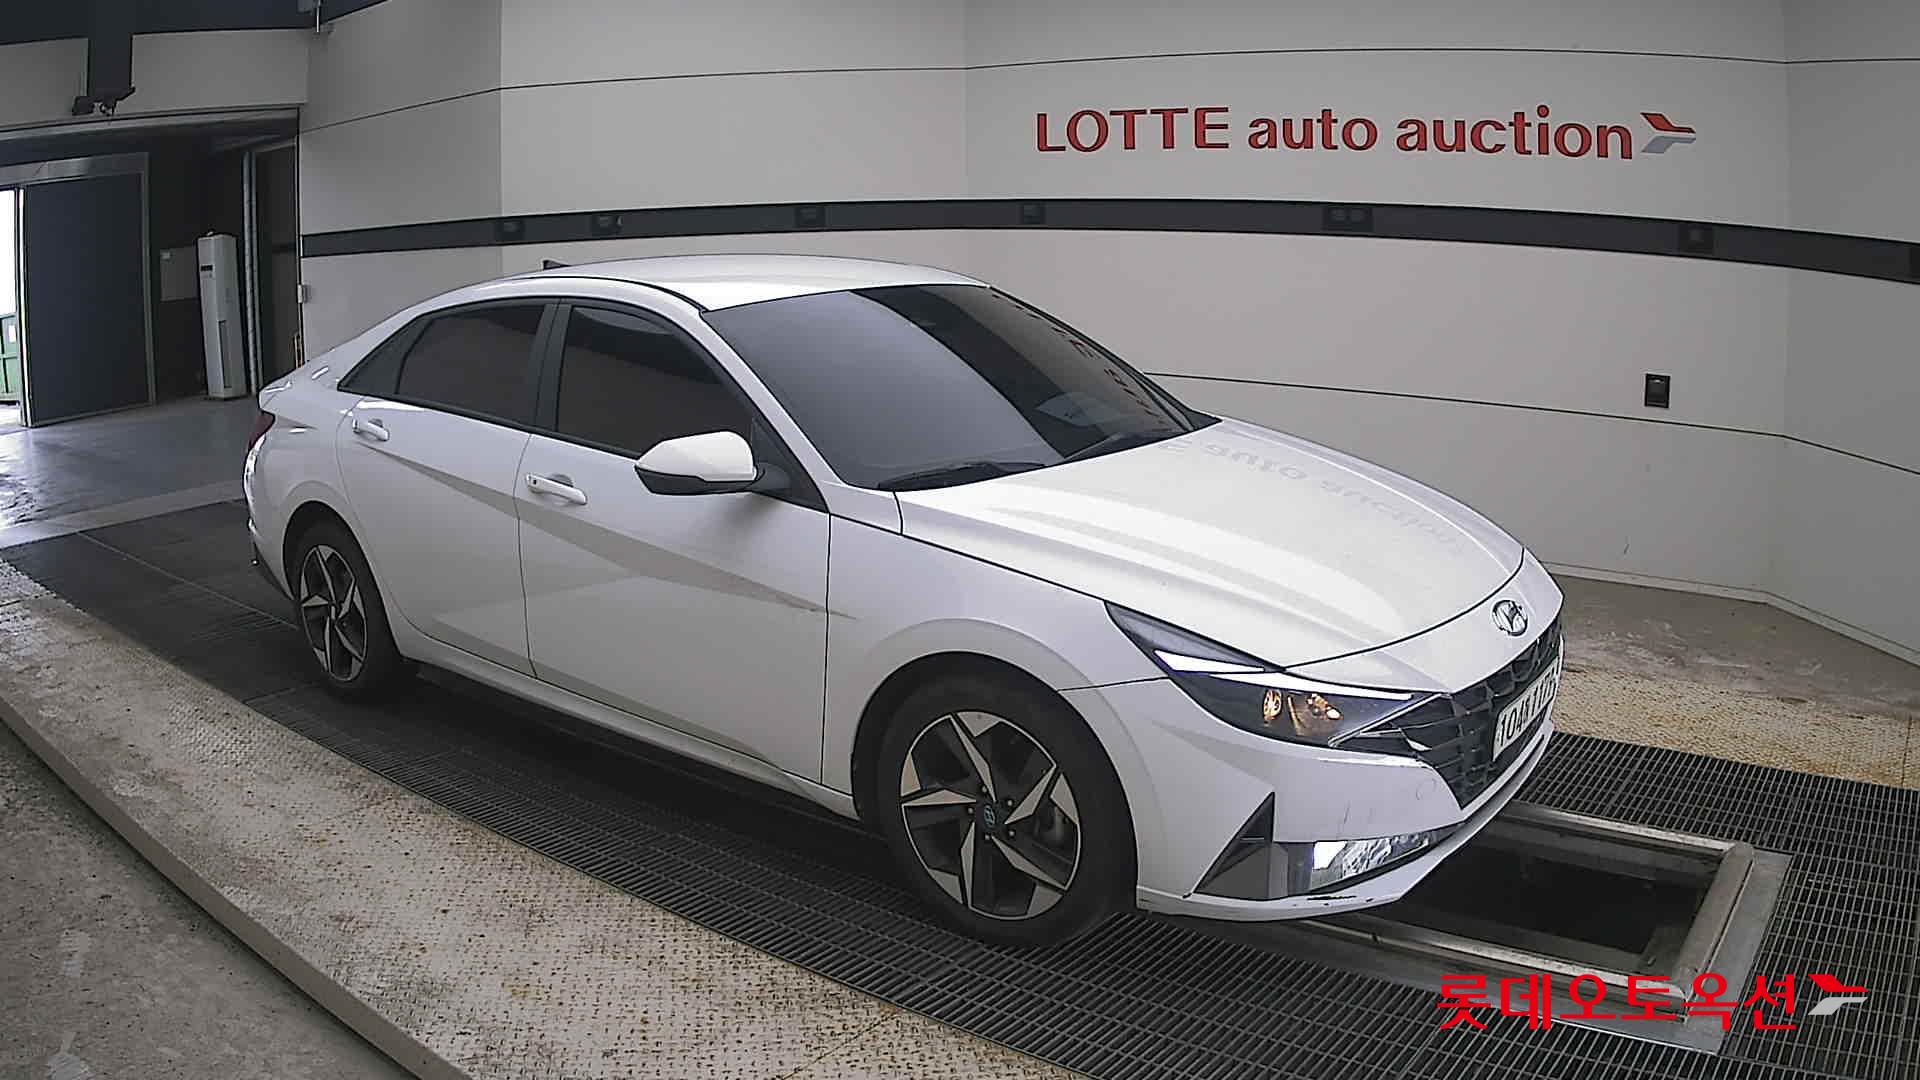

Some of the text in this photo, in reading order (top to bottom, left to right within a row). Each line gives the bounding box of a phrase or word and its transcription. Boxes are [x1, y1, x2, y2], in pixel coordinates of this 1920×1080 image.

[1036, 104, 1633, 160] LOTTE auto auction
